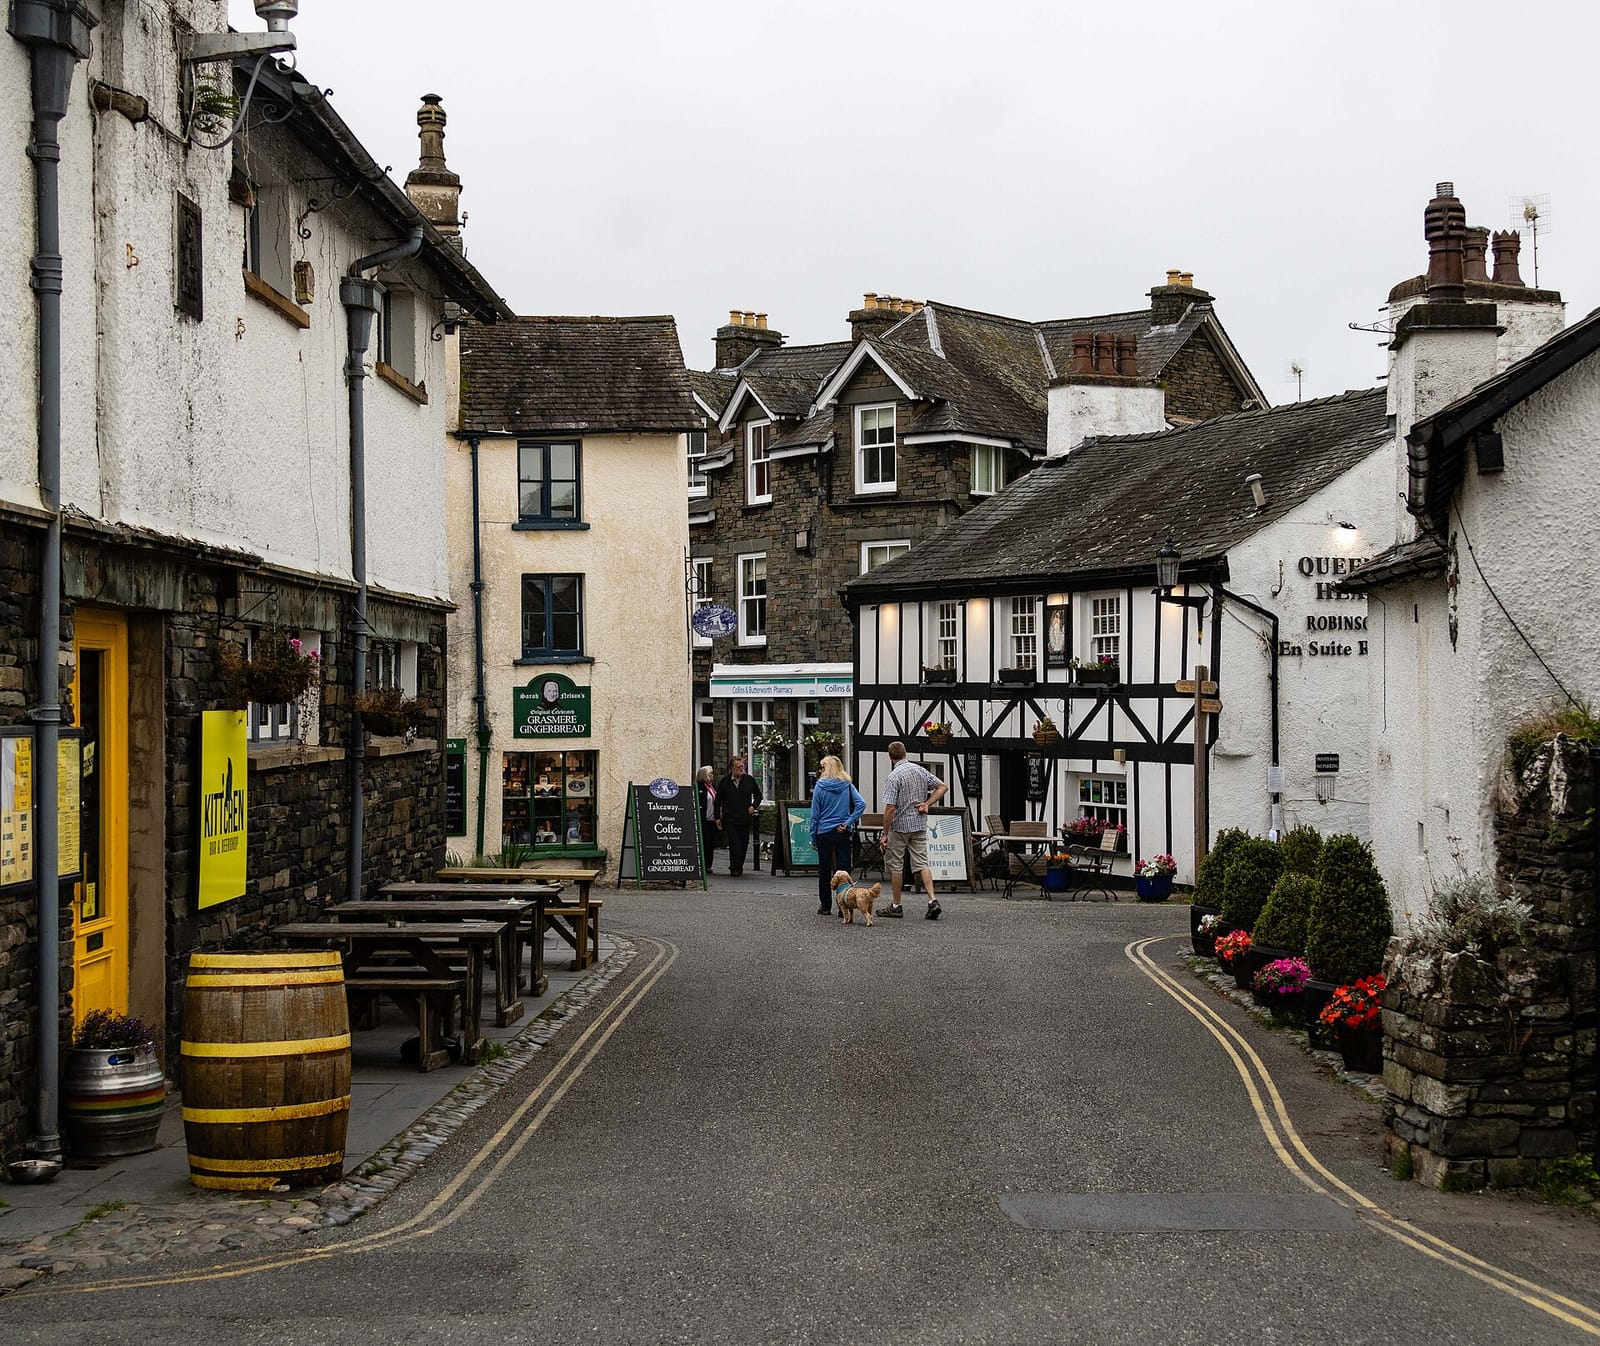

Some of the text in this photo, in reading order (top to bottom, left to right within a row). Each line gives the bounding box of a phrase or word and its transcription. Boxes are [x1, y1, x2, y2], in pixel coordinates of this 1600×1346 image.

[1298, 556, 1370, 577] QUEE
[1279, 641, 1302, 656] En
[1308, 640, 1352, 656] Suite
[732, 686, 745, 694] Collins
[773, 686, 793, 695] Pharmacy
[825, 684, 851, 693] Collins &
[527, 715, 577, 724] GRASMERE
[654, 823, 682, 834] Coffee
